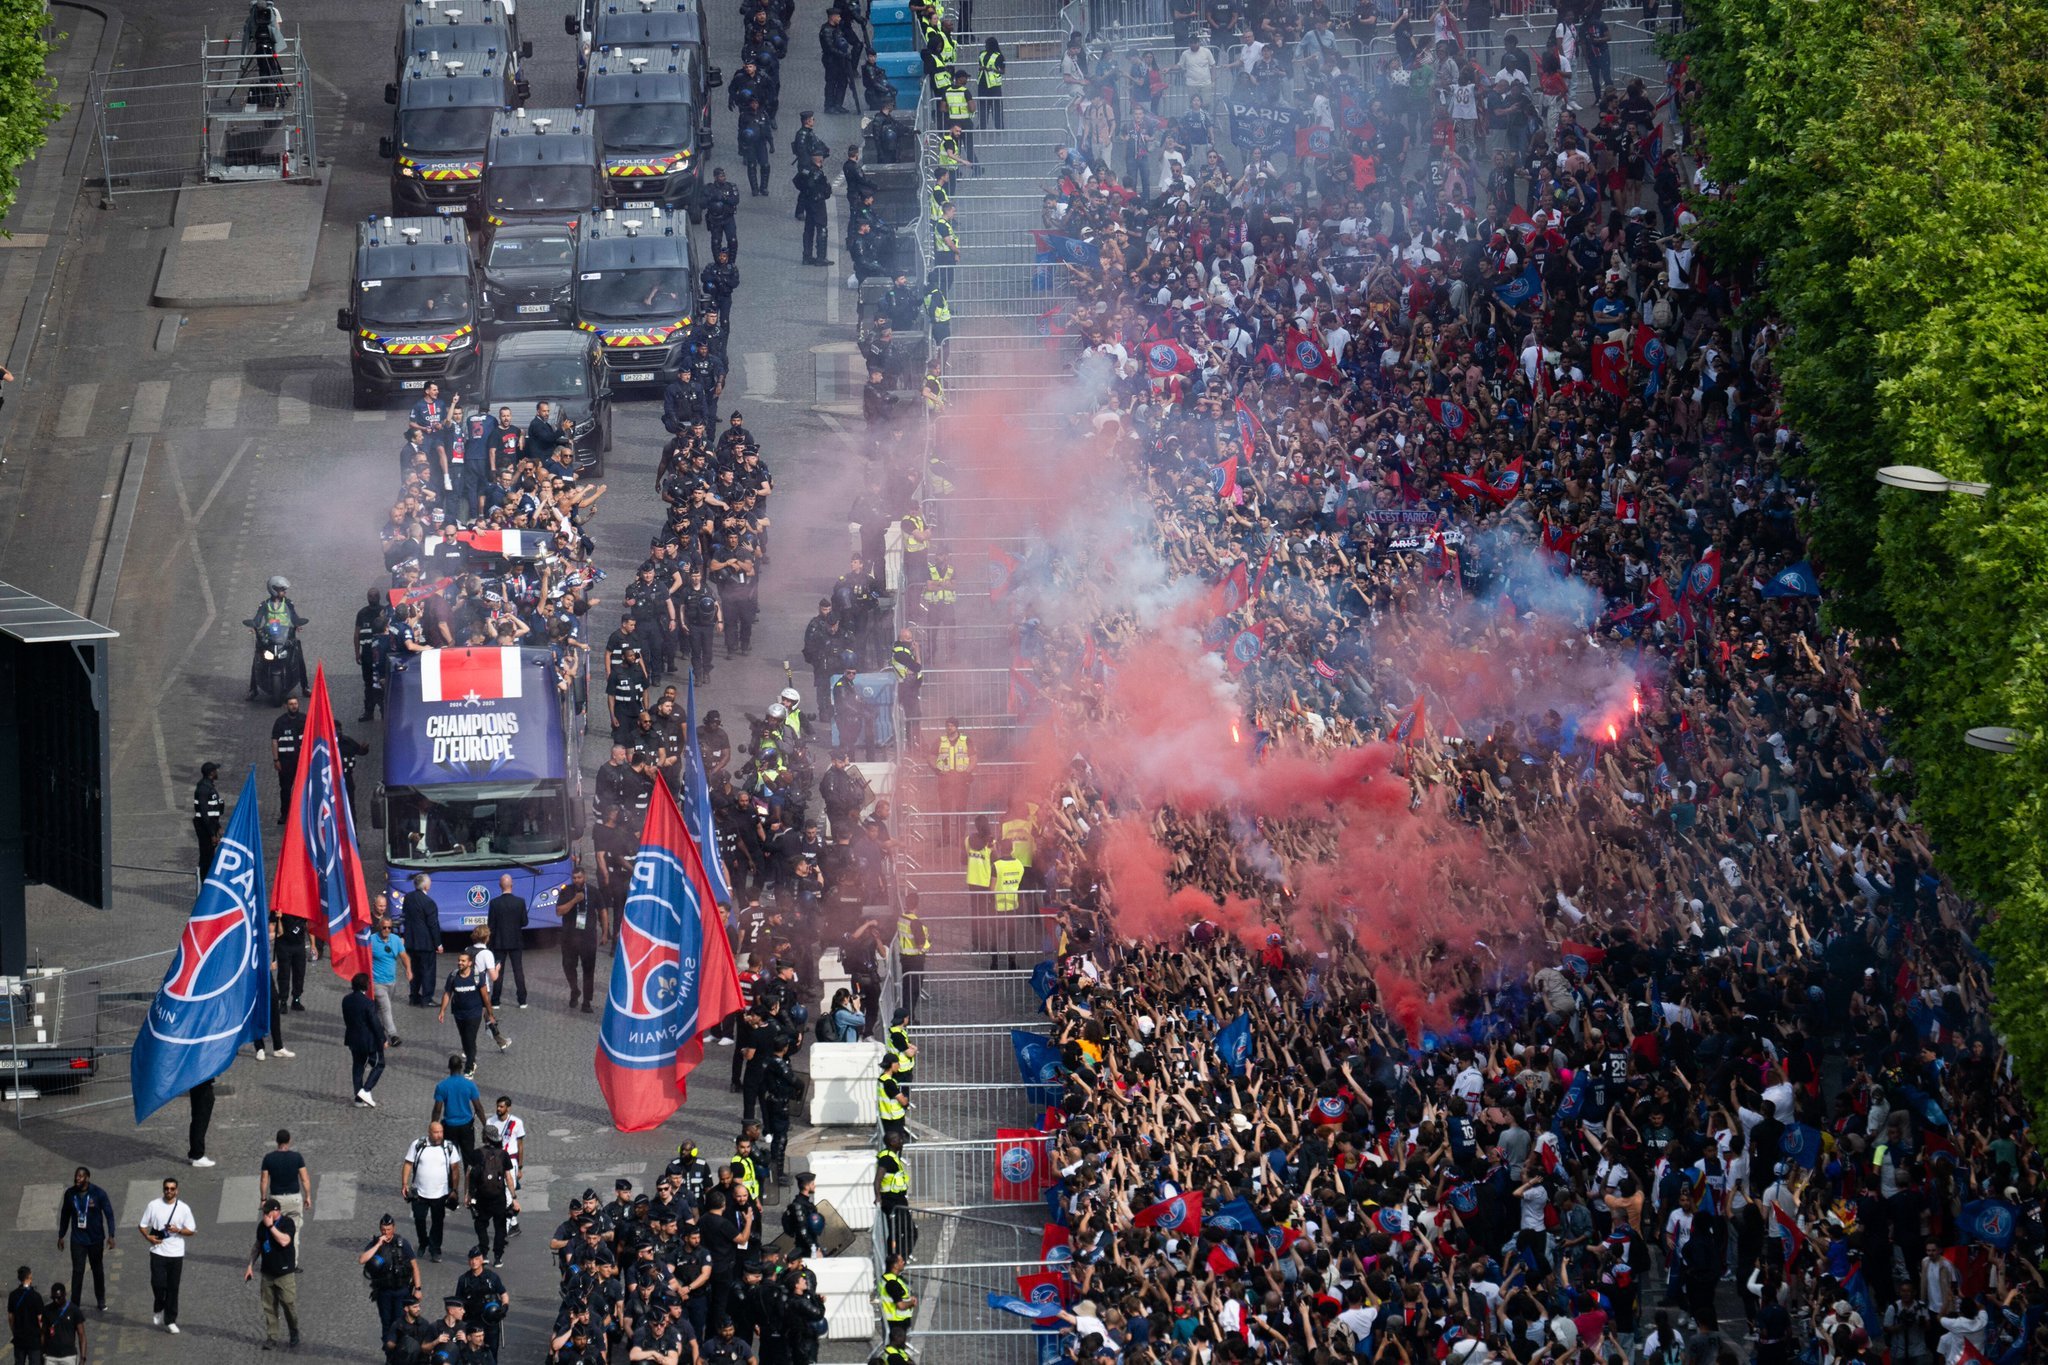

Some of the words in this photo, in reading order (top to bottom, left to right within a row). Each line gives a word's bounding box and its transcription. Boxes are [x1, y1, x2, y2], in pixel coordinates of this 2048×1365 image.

[1233, 104, 1291, 124] PARIS
[426, 712, 519, 737] CHAMPIONS
[433, 735, 515, 763] D'EUROPE
[1611, 1060, 1627, 1077] 29
[1461, 1125, 1473, 1139] 10
